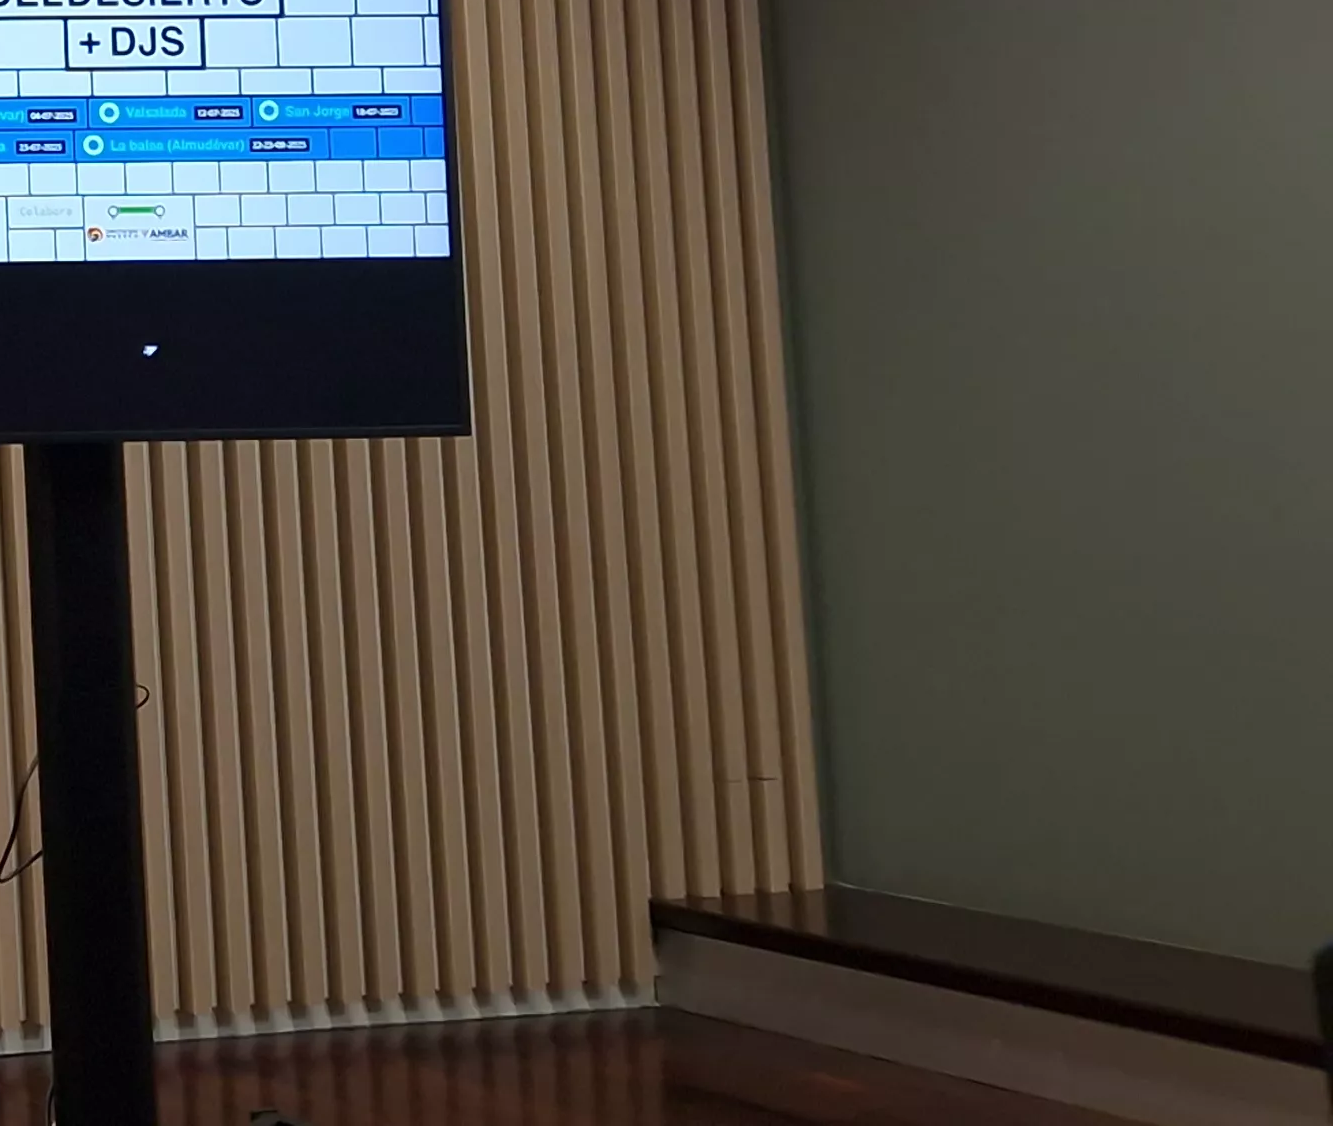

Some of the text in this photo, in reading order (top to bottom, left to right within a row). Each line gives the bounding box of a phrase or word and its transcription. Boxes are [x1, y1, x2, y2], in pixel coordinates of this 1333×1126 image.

[111, 26, 186, 58] DJS
[285, 106, 310, 117] San
[314, 105, 350, 120] Jorge
[110, 140, 126, 151] La
[168, 138, 245, 153] (Almudévar)
